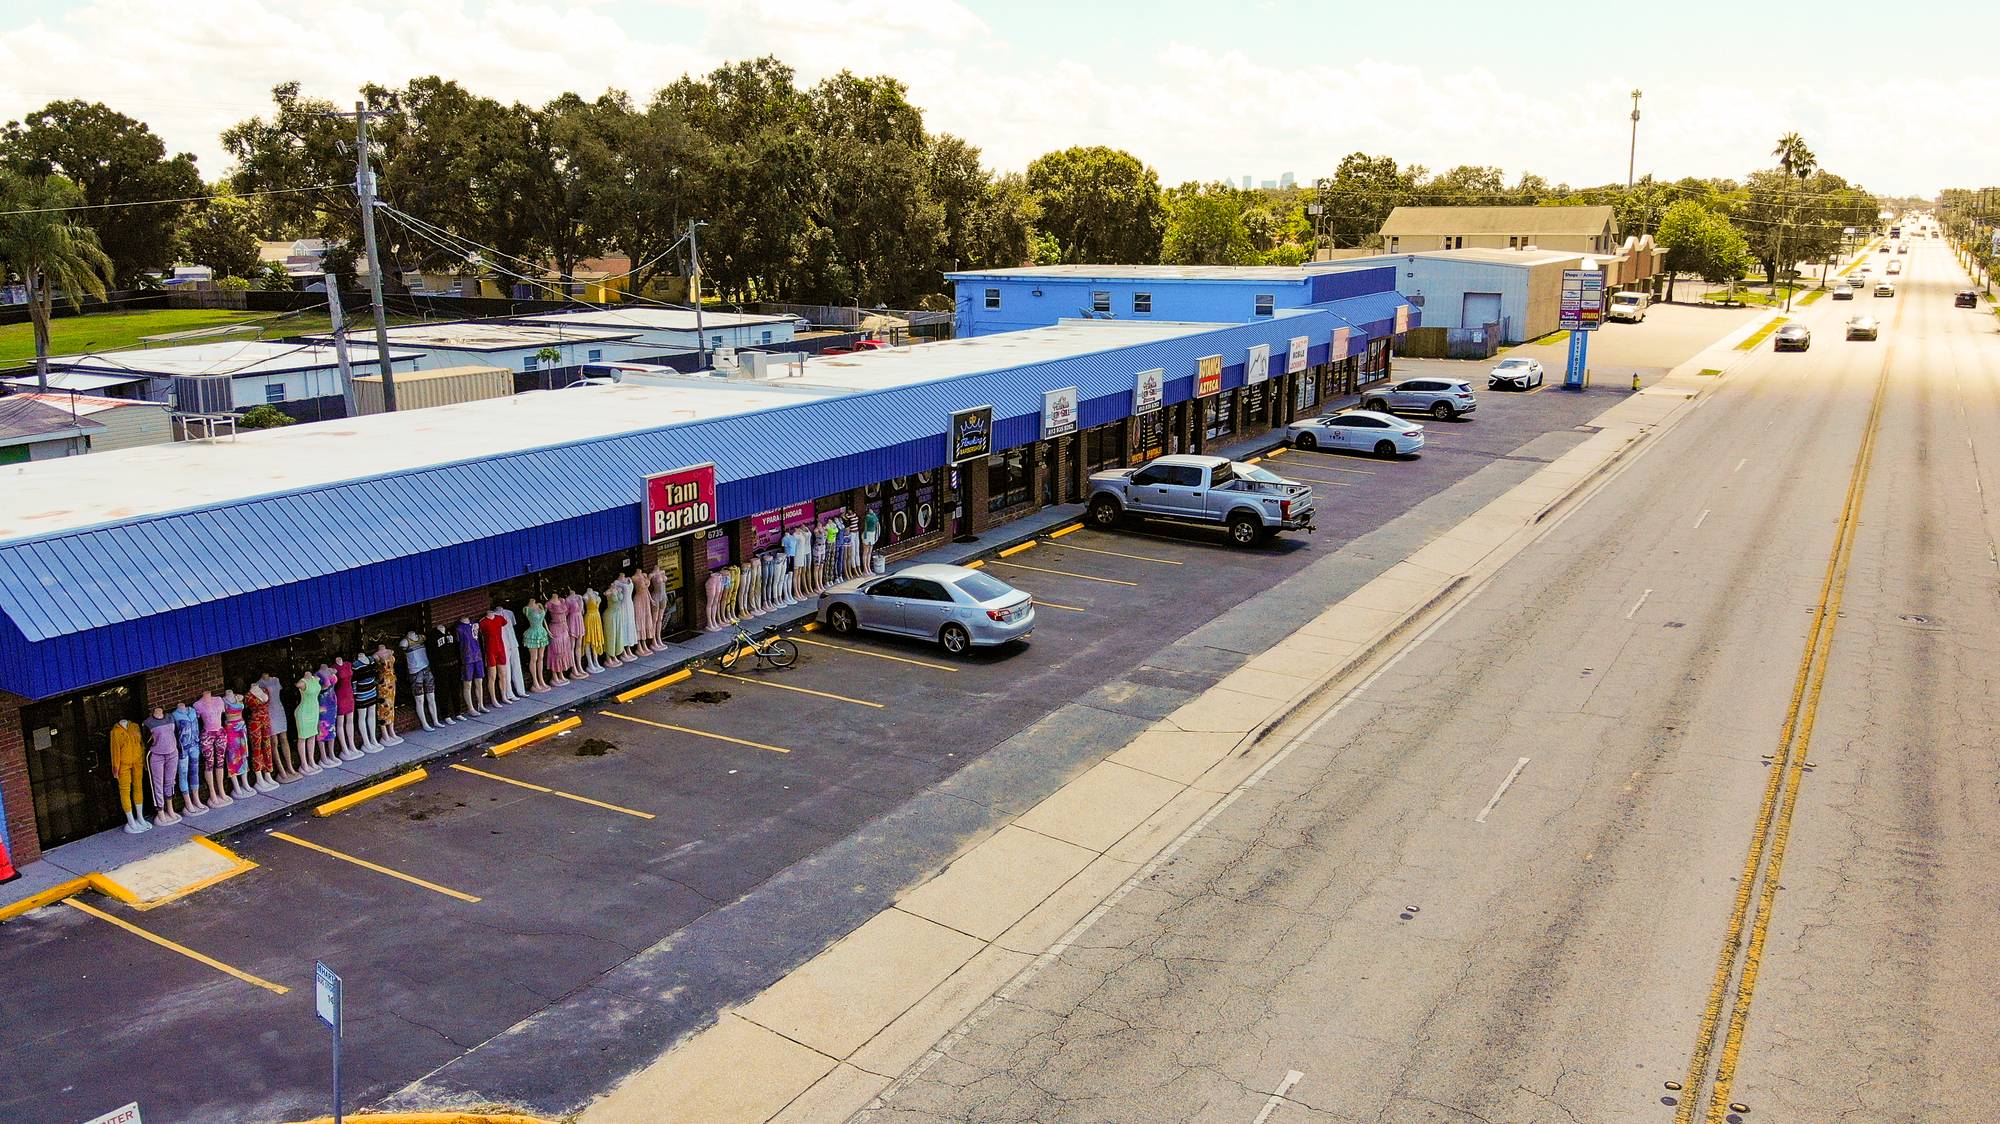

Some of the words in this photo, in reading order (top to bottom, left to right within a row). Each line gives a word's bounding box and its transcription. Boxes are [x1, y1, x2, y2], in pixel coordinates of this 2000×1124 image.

[1199, 379, 1219, 395] AZTECA
[666, 482, 698, 506] Tam
[654, 501, 710, 534] Barato
